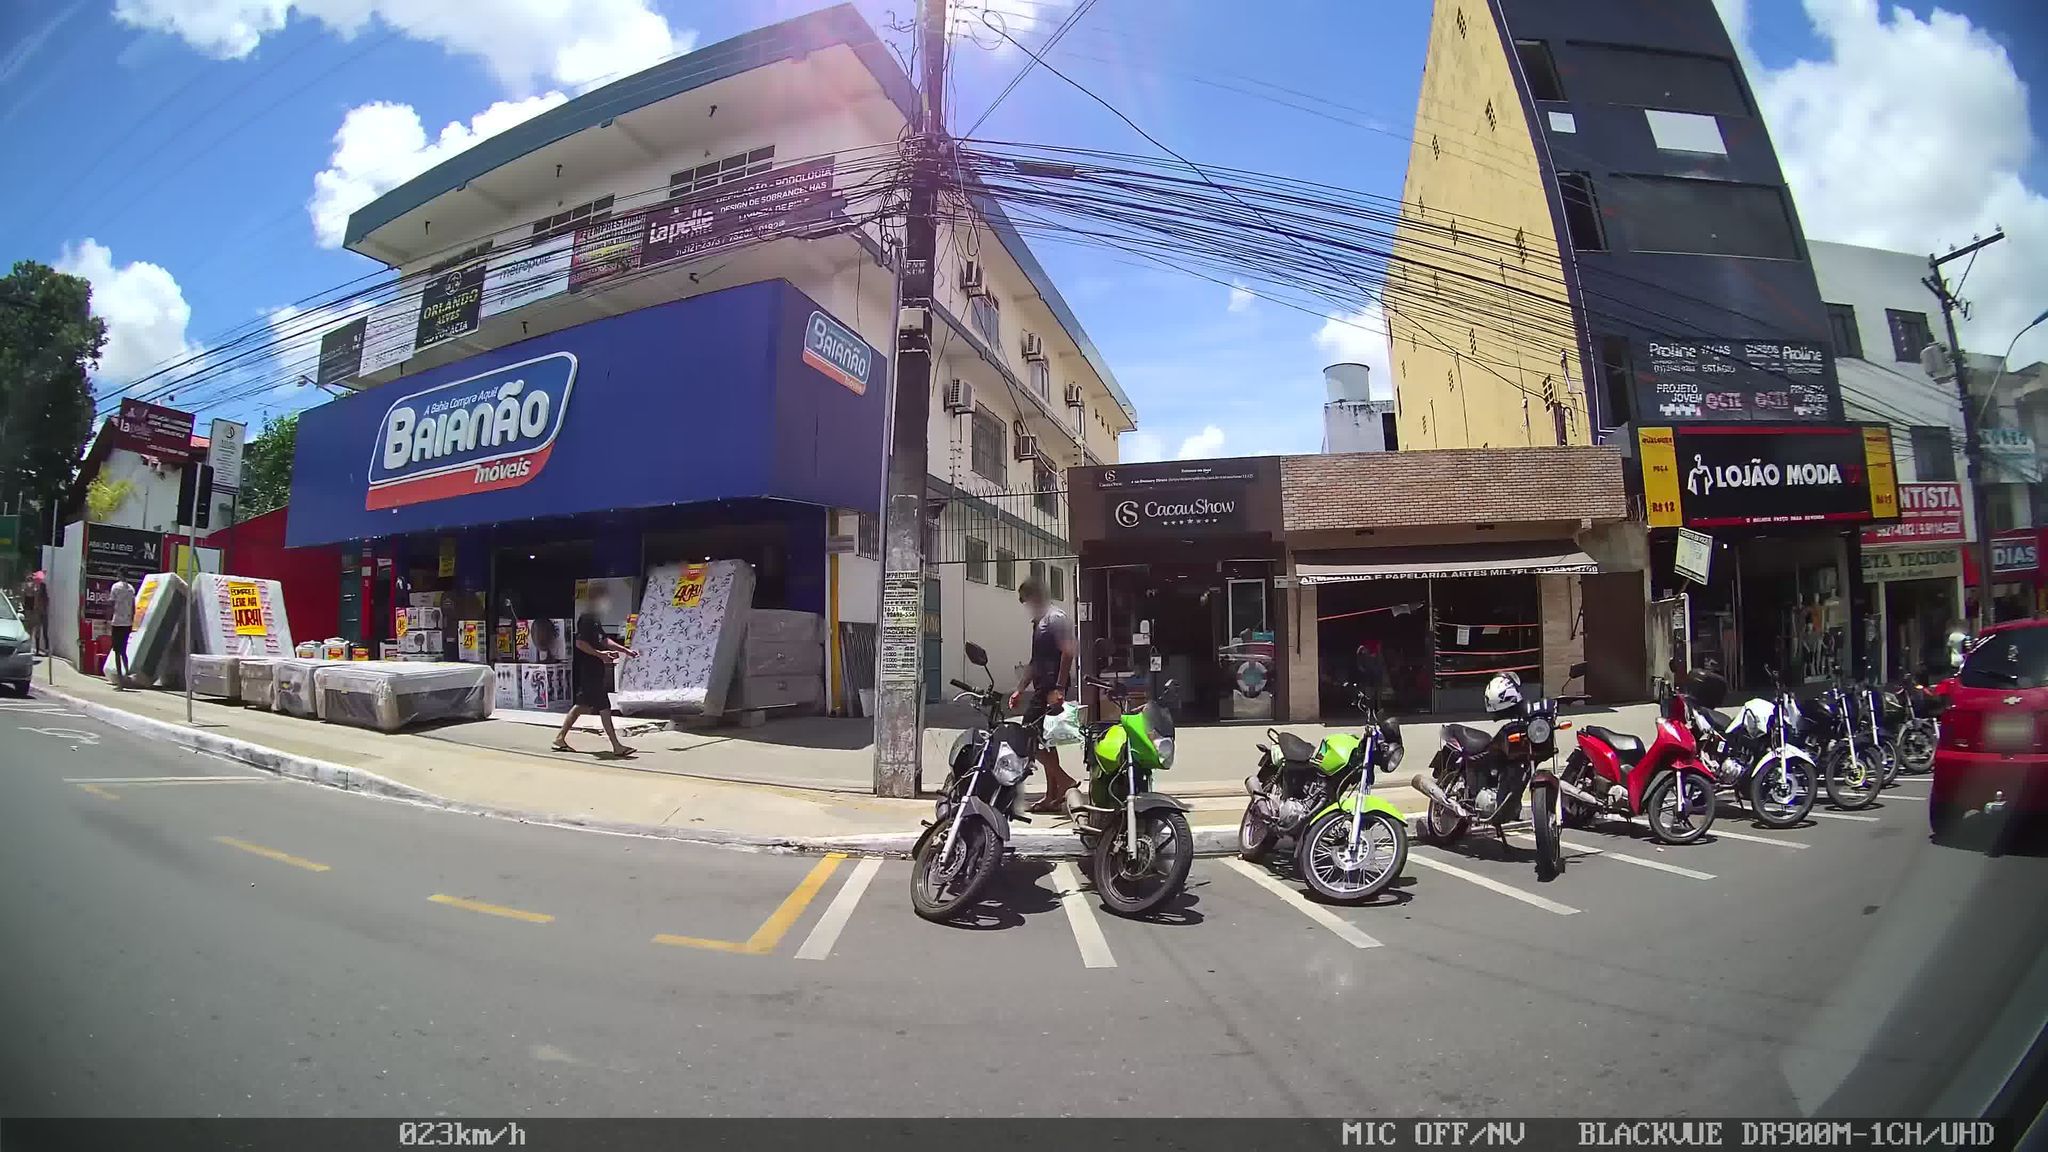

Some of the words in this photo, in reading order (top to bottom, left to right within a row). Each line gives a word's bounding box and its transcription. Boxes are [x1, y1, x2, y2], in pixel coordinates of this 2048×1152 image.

[748, 198, 760, 206] DE
[423, 288, 478, 320] ORLANDO
[814, 318, 867, 377] BAIANÃO
[423, 406, 432, 417] A
[431, 401, 449, 414] Bahia
[449, 393, 478, 411] Compra
[478, 386, 499, 402] Aqui!
[1656, 383, 1698, 393] PROJETO
[1671, 393, 1703, 403] JOVEM
[383, 379, 551, 470] BAIANÃO
[474, 457, 533, 484] móveis
[1715, 457, 1781, 488] LOJÃO
[1786, 463, 1843, 486] MODA
[1995, 546, 2037, 562] DIAS
[1385, 571, 1448, 580] PAPELARIA
[1451, 568, 1488, 578] ARTES
